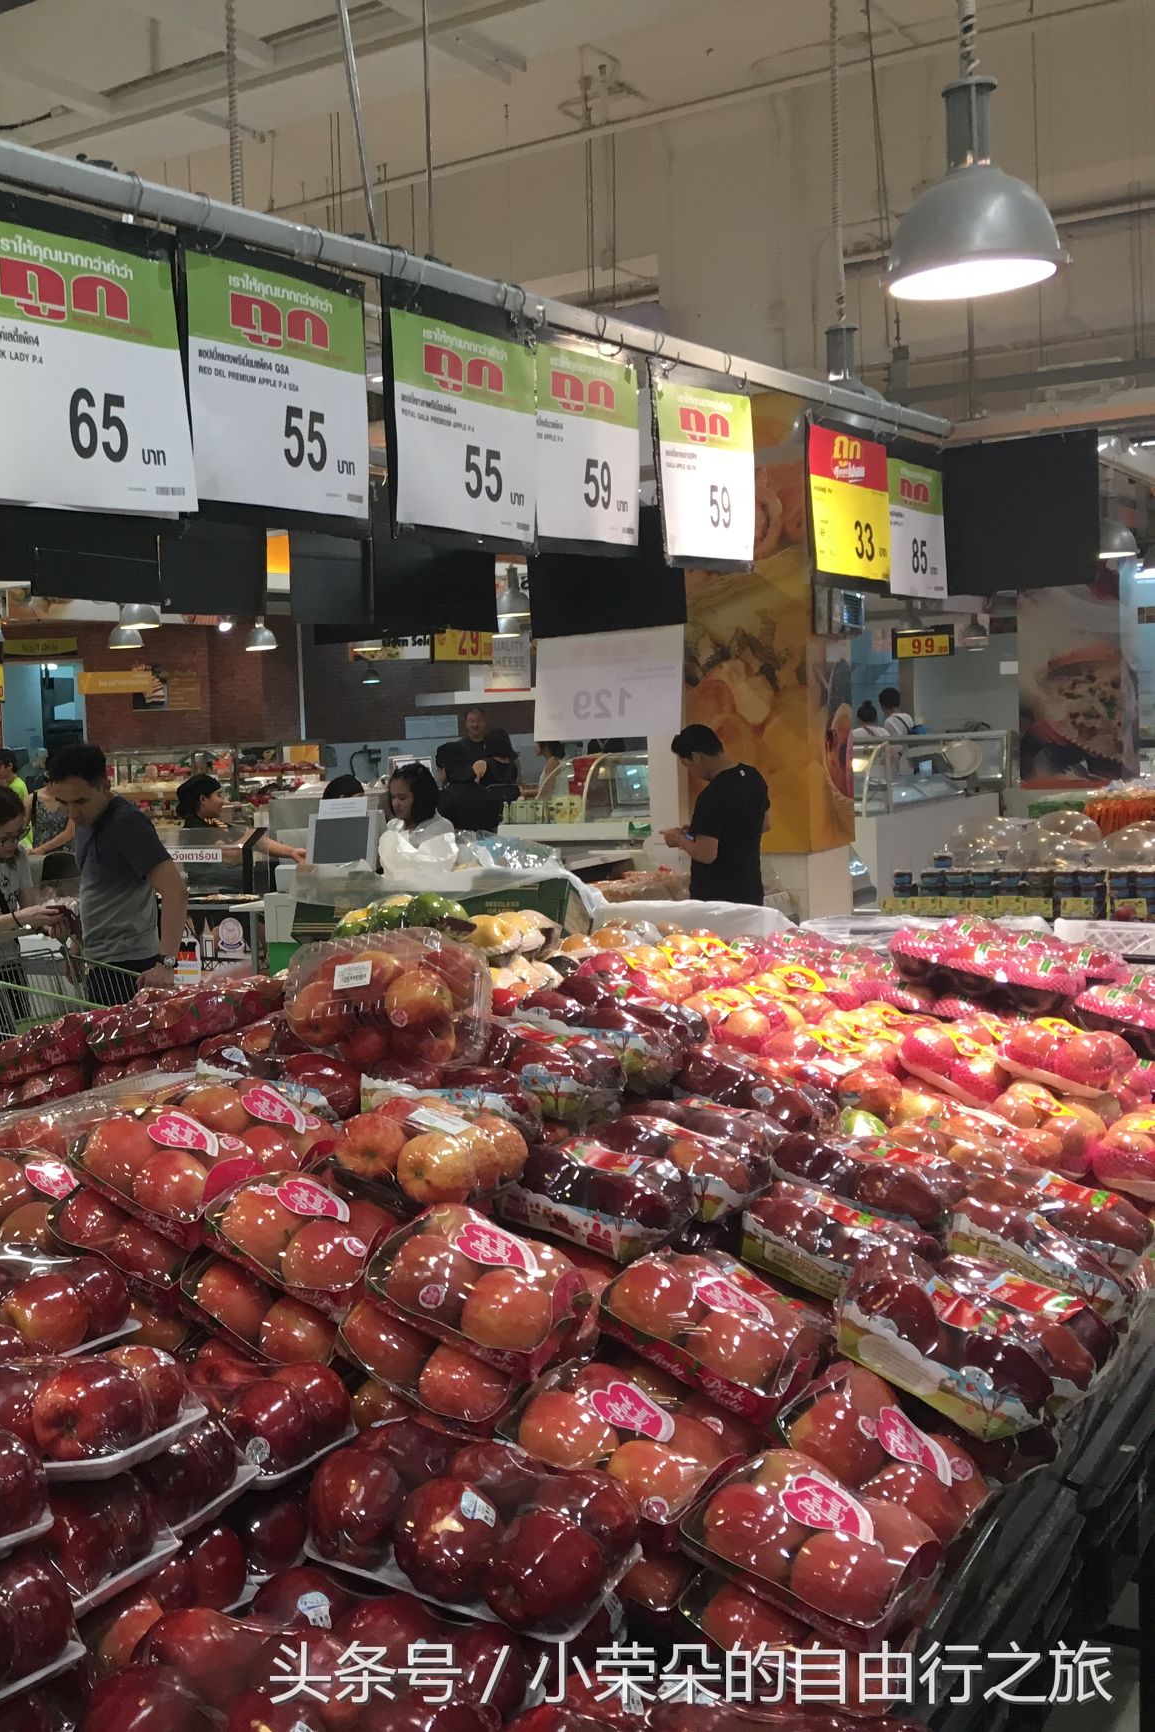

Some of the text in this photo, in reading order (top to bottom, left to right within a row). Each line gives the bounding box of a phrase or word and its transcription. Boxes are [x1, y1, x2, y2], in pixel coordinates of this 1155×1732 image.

[9, 350, 30, 364] LADY
[198, 364, 213, 376] RED
[214, 367, 227, 379] DEL
[227, 370, 257, 385] PREMIUM
[257, 375, 277, 389] APPLE
[69, 387, 129, 464] 65
[283, 405, 328, 473] 55
[142, 447, 167, 467] บาท
[465, 443, 503, 503] 55
[584, 457, 612, 511] 59
[709, 484, 732, 530] 59
[854, 520, 876, 562] 33
[912, 537, 928, 575] 85
[496, 640, 525, 652] UALITY
[496, 656, 525, 668] HEESE
